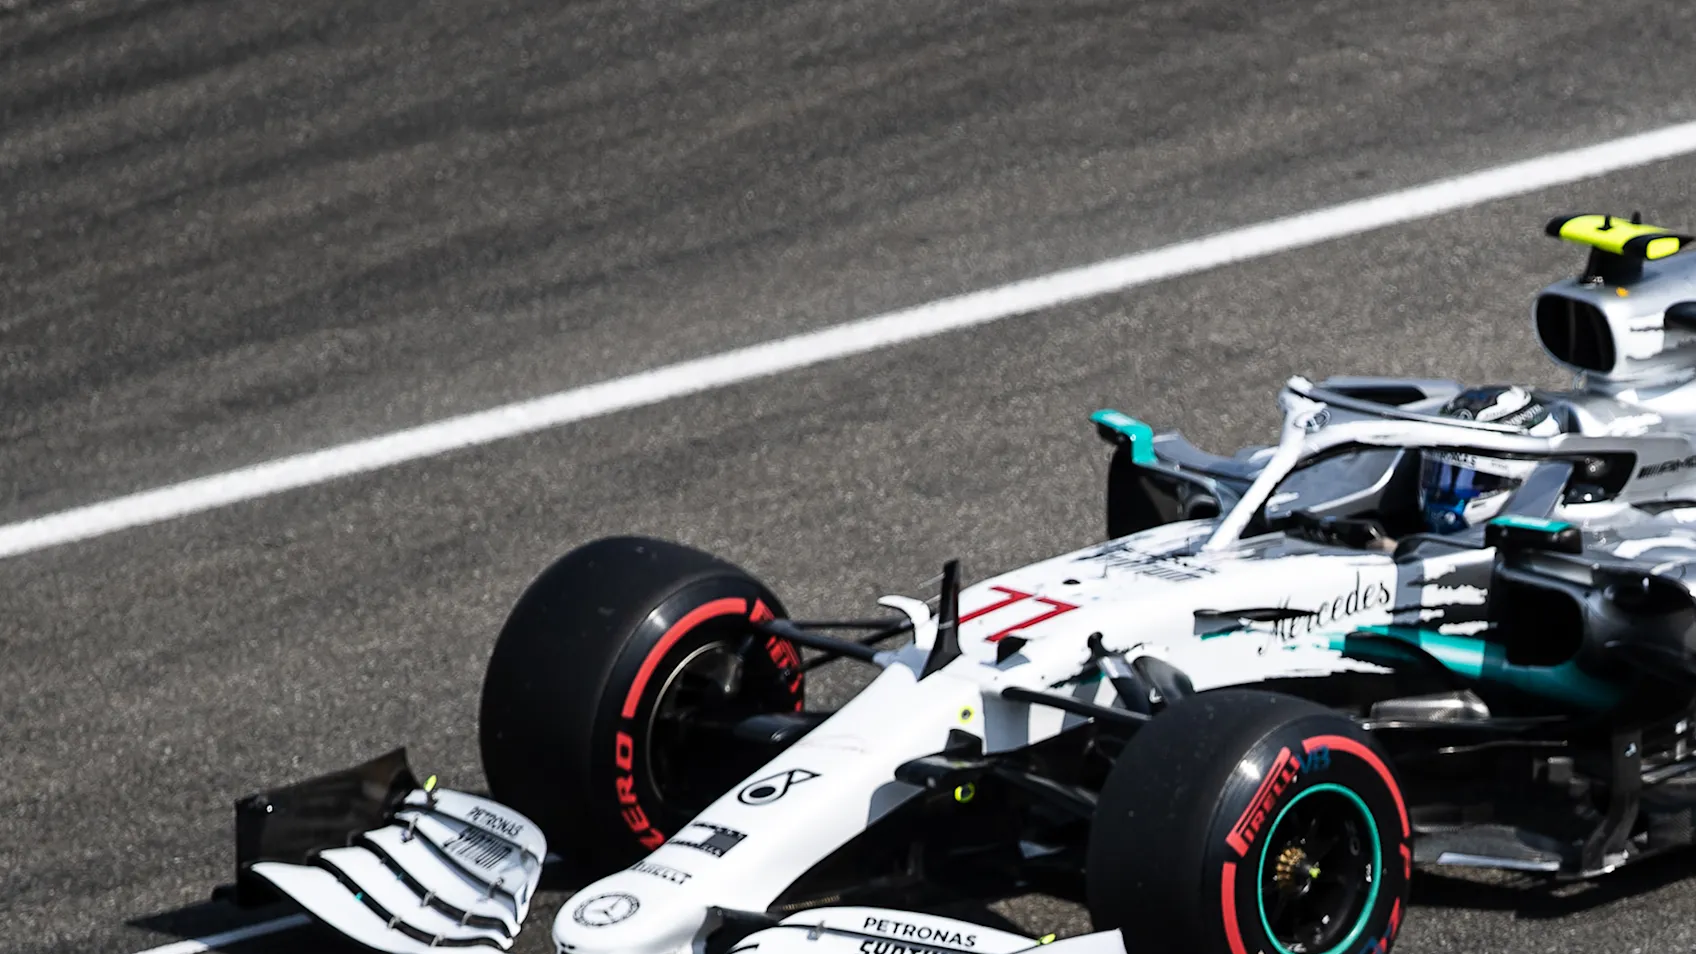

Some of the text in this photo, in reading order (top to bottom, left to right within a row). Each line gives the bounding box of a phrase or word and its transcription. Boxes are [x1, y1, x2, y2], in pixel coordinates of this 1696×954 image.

[957, 584, 1082, 643] 77
[1225, 745, 1302, 858] PIRELLI
[864, 915, 977, 948] PETRONAS
